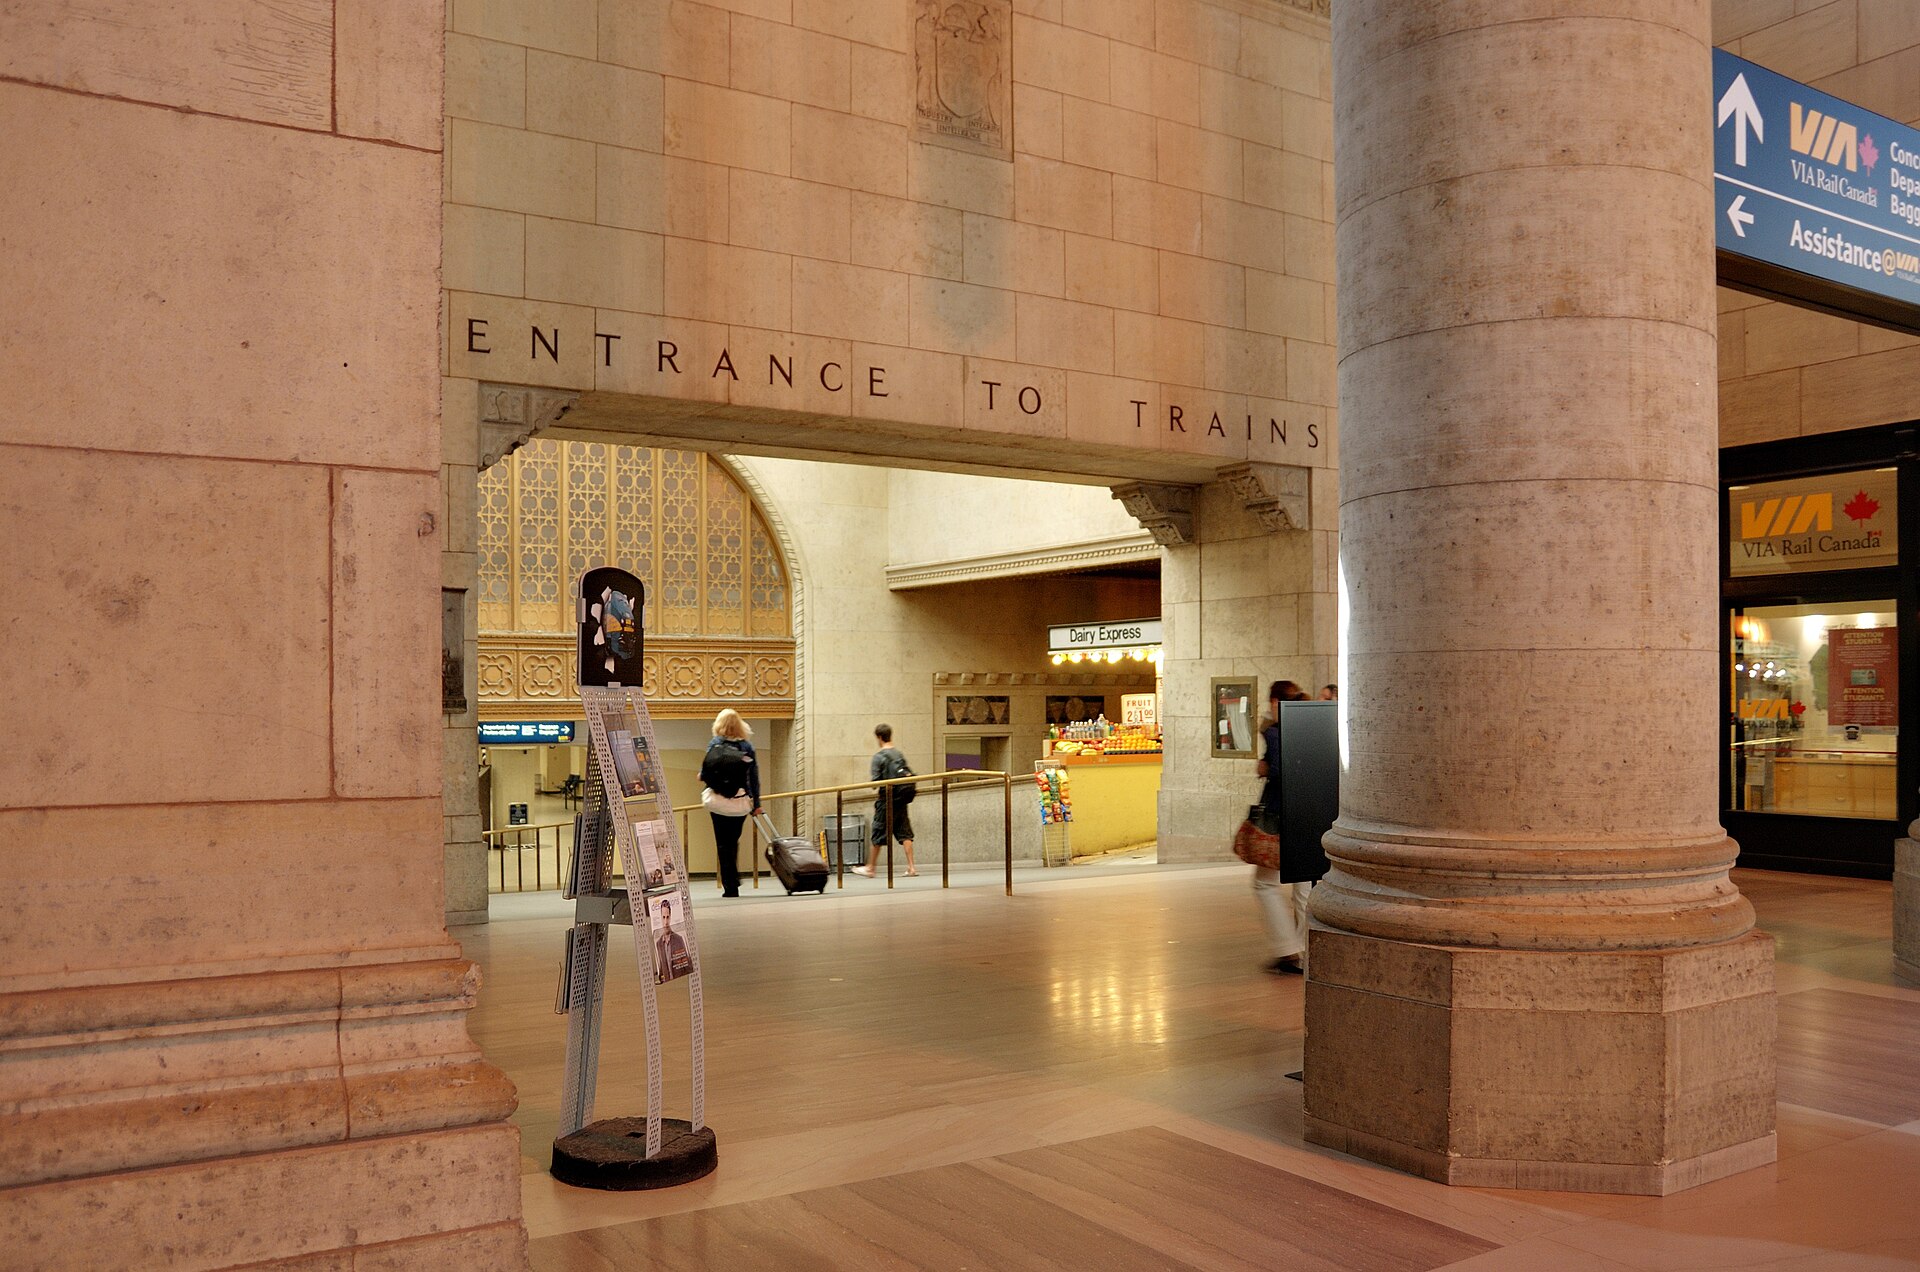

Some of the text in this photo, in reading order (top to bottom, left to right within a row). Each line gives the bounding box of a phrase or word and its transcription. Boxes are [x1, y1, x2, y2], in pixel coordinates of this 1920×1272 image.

[1790, 101, 1857, 173] VIA
[1791, 159, 1878, 208] VIA Rail Canada
[467, 318, 1319, 448] ENTRANCE TO TRAINS
[1741, 492, 1833, 539] VIA
[1742, 531, 1881, 559] VIA Rail Canada
[1070, 626, 1142, 644] Dairy Express
[1126, 699, 1152, 707] FRUIT
[1843, 687, 1885, 695] ATTENTION
[1127, 711, 1133, 722] 2
[1739, 698, 1789, 718] VIA
